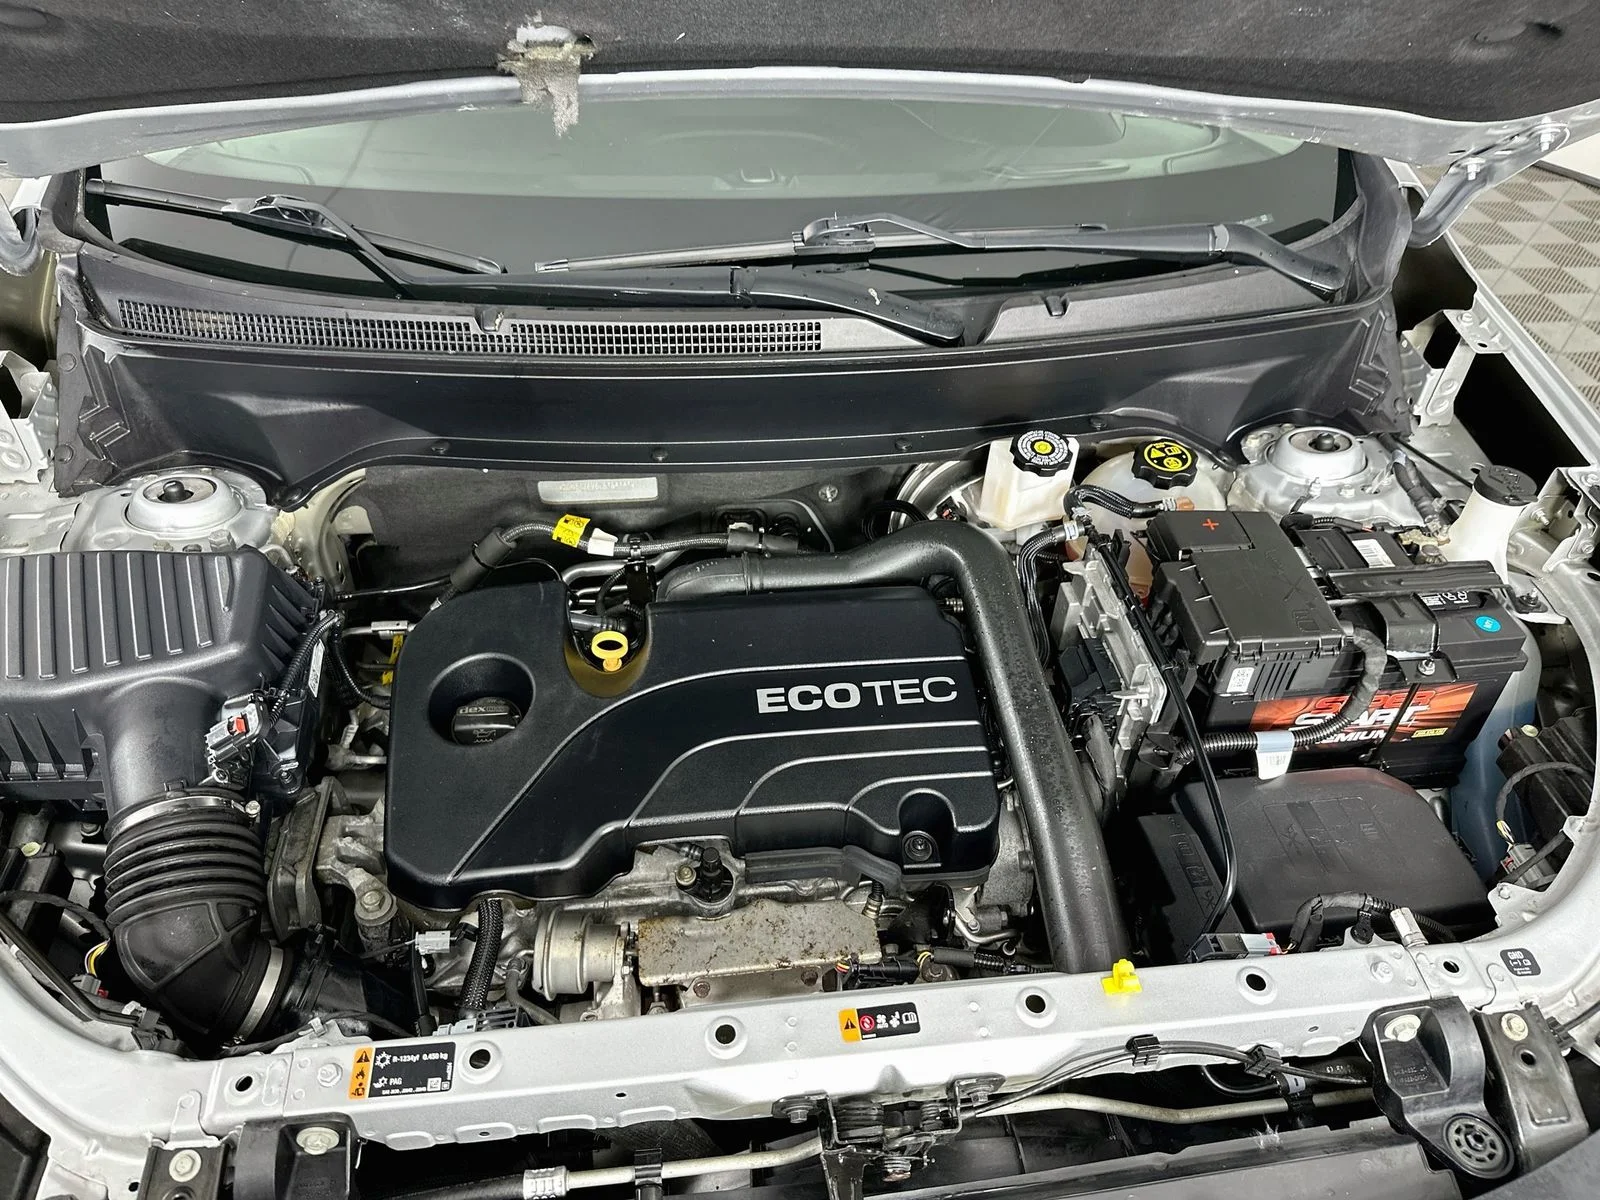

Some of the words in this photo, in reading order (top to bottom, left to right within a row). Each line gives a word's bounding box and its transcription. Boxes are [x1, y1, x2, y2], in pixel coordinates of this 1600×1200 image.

[756, 676, 958, 714] ECOTEC
[1310, 690, 1436, 715] SPER
[1288, 705, 1430, 732] SART
[440, 1052, 448, 1060] kg
[390, 1078, 402, 1086] PAG
